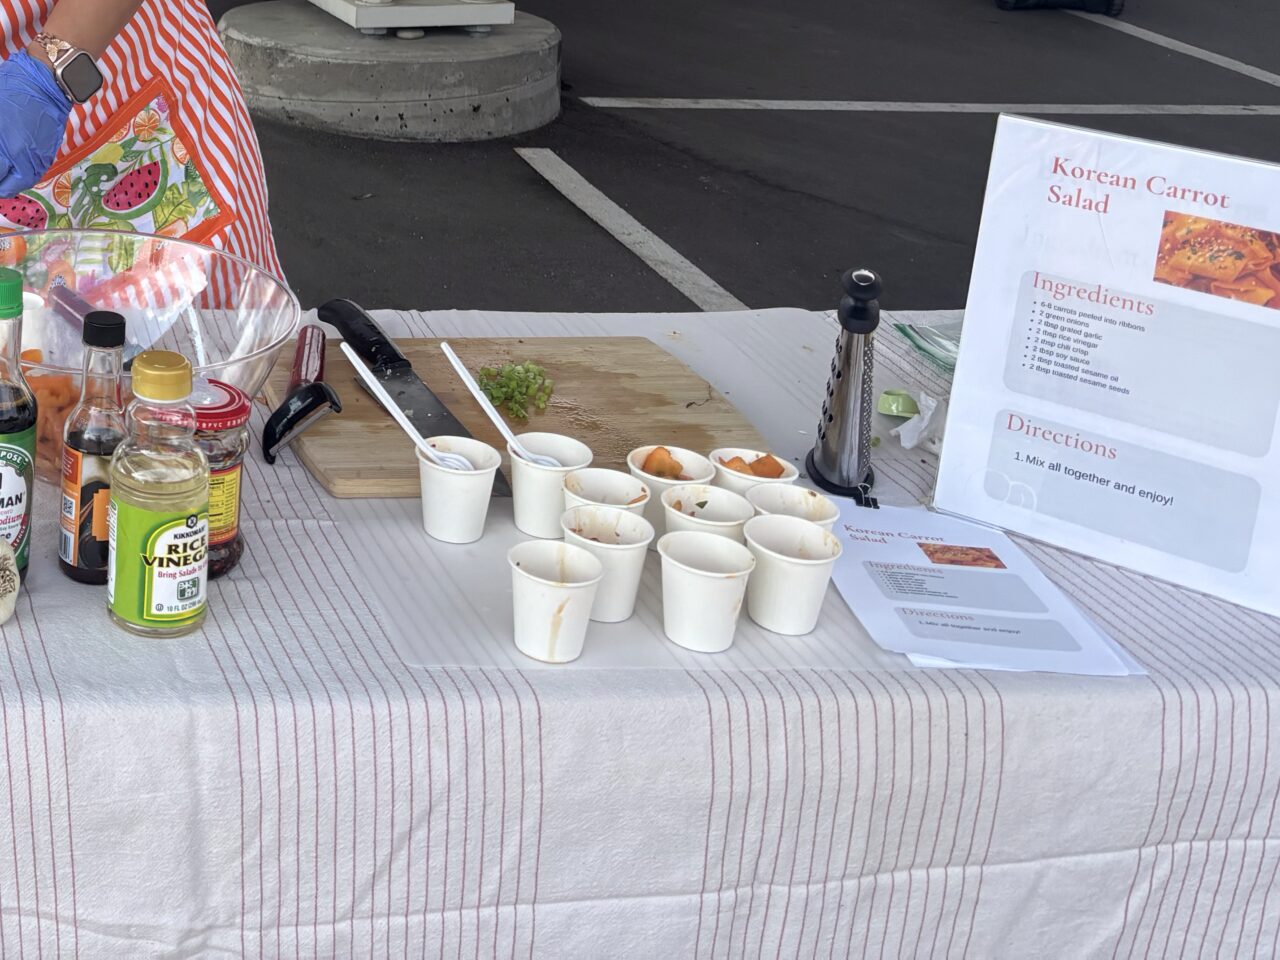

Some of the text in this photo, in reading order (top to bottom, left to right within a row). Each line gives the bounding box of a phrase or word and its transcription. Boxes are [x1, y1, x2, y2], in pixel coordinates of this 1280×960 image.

[1052, 156, 1231, 208] Korean Carrot
[1047, 184, 1109, 214] Salad
[1033, 271, 1155, 316] Ingredients
[1045, 312, 1065, 323] green
[1053, 304, 1077, 316] carrots
[1078, 311, 1103, 322] peeled
[1118, 321, 1145, 332] ribbons
[1055, 352, 1068, 361] soy
[1108, 384, 1130, 395] seeds
[1007, 413, 1117, 460] Directions
[1014, 451, 1174, 506] 1. Mix all together and enjoy!
[844, 524, 944, 542] Korean Carrot
[849, 534, 887, 544] Salad
[168, 534, 206, 554] RICE
[158, 570, 177, 580] Bring
[179, 566, 196, 577] Salads
[869, 562, 944, 574] Ingredients
[900, 608, 976, 622] Directions
